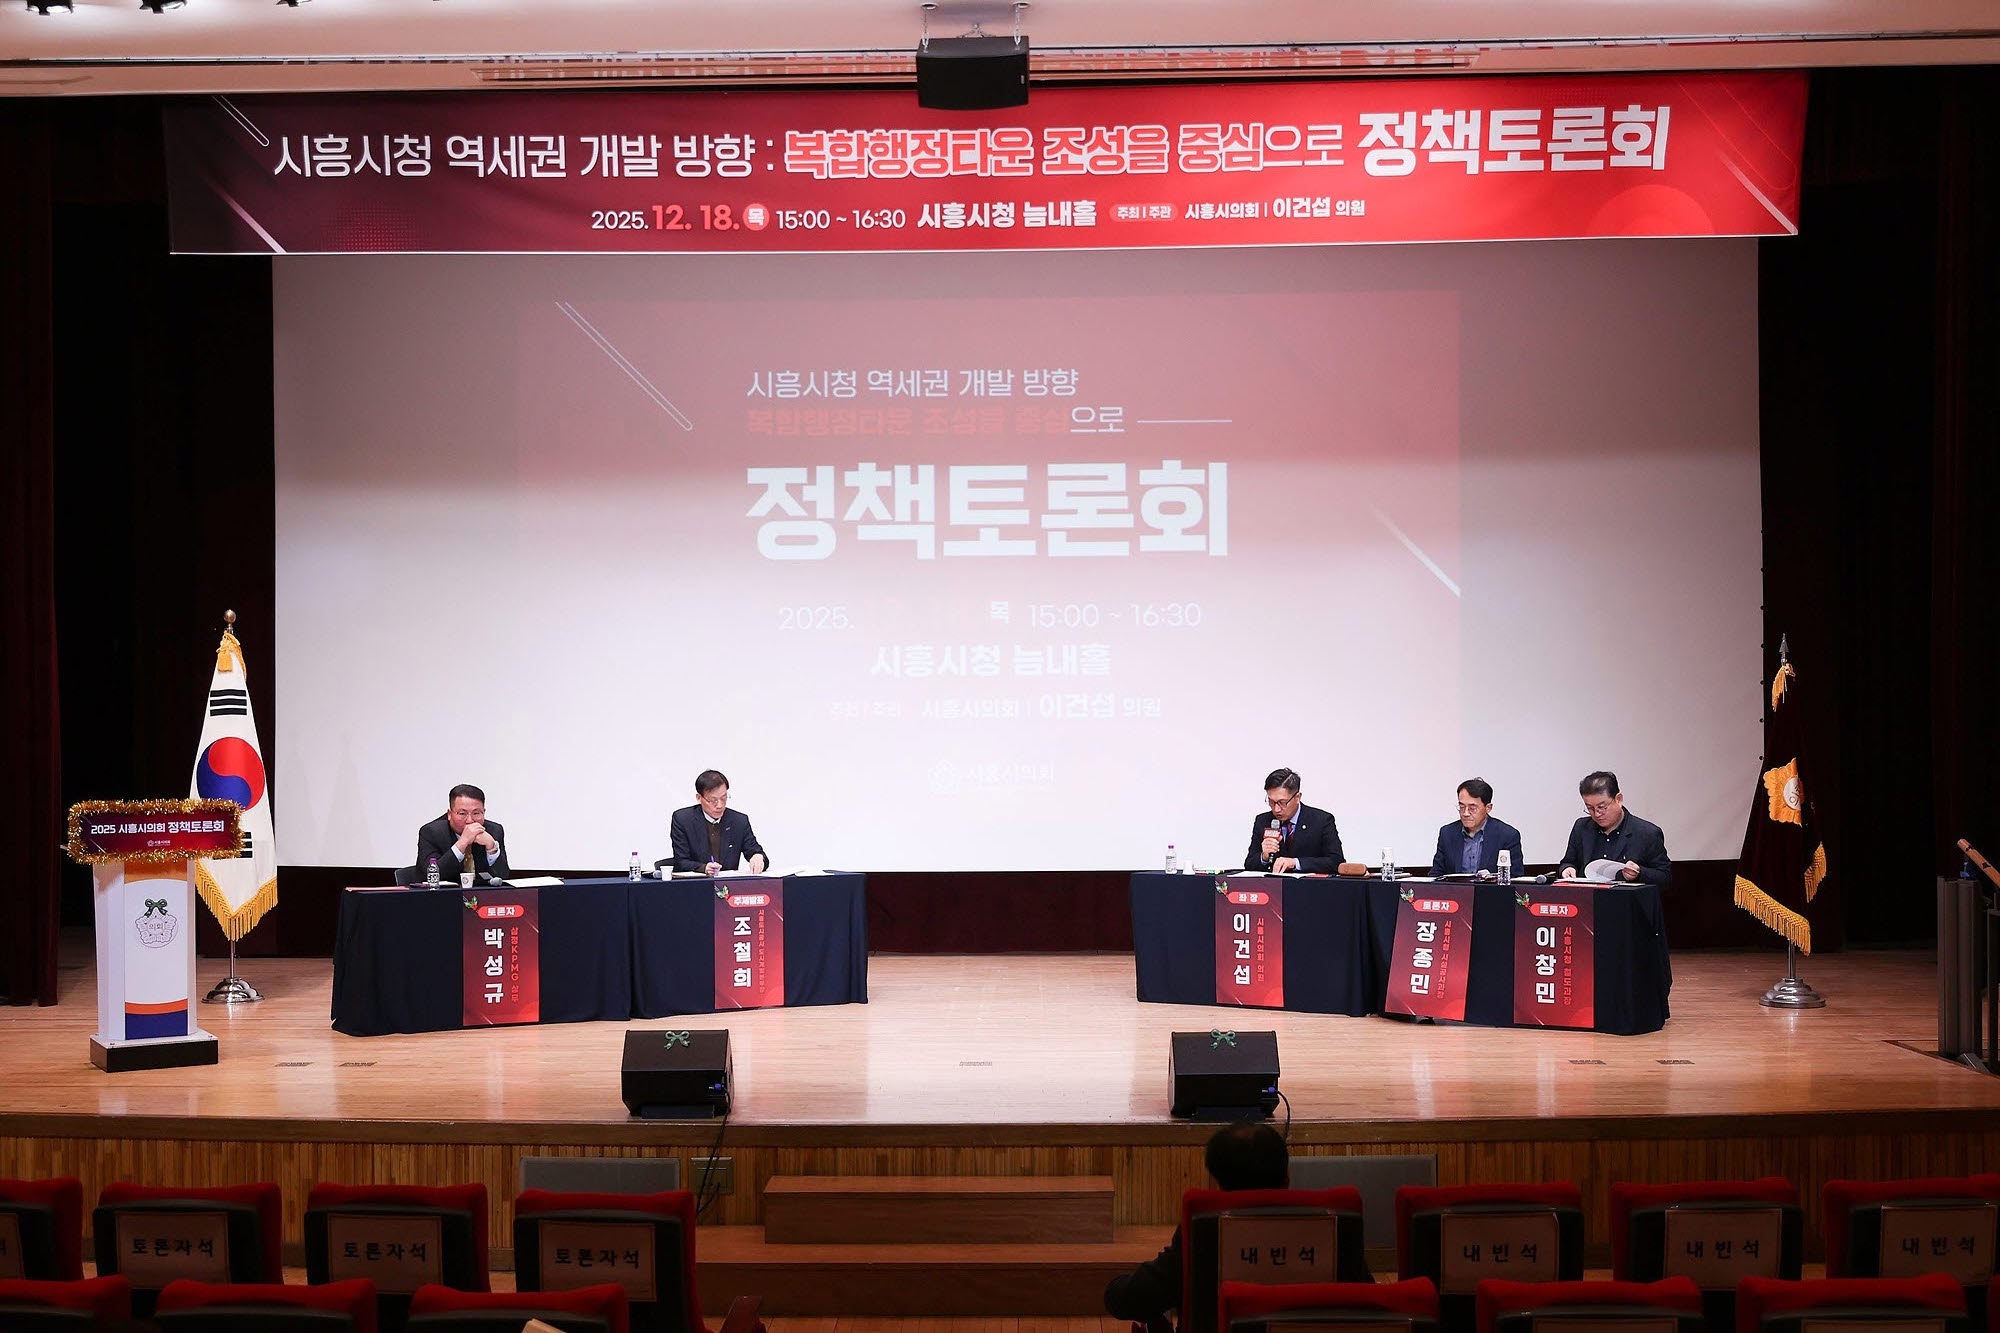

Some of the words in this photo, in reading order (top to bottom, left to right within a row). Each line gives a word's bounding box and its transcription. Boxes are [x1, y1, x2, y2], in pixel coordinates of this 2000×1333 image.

[274, 133, 432, 178] 시흥시청
[445, 133, 567, 178] 역세권
[580, 133, 660, 177] 개발
[673, 133, 756, 178] 방향
[785, 127, 1034, 180] 복합행정타운
[1043, 124, 1170, 176] 조성을
[1178, 122, 1346, 174] 중심으로
[1357, 105, 1671, 177] 정책토론회
[591, 211, 649, 230] 2025.
[652, 205, 692, 231] 12.
[701, 205, 740, 231] 18.
[748, 208, 765, 226] 목
[776, 210, 830, 229] 15:00
[853, 209, 906, 229] 16:30
[917, 202, 1015, 229] 시흥시청
[1023, 200, 1097, 229] 늠내홀
[1117, 206, 1139, 219] 주최
[1149, 206, 1172, 219] 주관
[1185, 203, 1260, 220] 시흥시의회
[1272, 197, 1331, 218] 이건섭
[1335, 199, 1366, 217] 의원
[746, 370, 857, 398] 시흥시청
[867, 370, 949, 398] 역세권
[959, 369, 1014, 396] 개발
[1023, 369, 1079, 396] 방향
[745, 459, 1228, 560] 정책토론회
[777, 606, 855, 631] 2025.
[990, 601, 1010, 624] 목
[1029, 604, 1099, 628] 15:00
[1129, 603, 1202, 628] 16:30
[869, 643, 1000, 678] 시흥시청
[1012, 642, 1112, 677] 늠내홀
[1039, 692, 1116, 719] 이건섭
[91, 825, 116, 834] 2025
[119, 823, 166, 833] 시흥시의회
[168, 820, 225, 833] 정책토론회
[487, 906, 516, 917] 토론자
[1422, 901, 1450, 912] 토론자
[1539, 905, 1569, 915] 토론자
[733, 916, 752, 988] 조철희
[1233, 913, 1251, 985] 이건섭
[1410, 921, 1438, 995] 장종민
[484, 928, 505, 1004] 박성규
[1535, 926, 1557, 1004] 이창민
[132, 1237, 214, 1258] 토론자석
[343, 1240, 427, 1263] 토론자석
[555, 1246, 640, 1269] 토론자석
